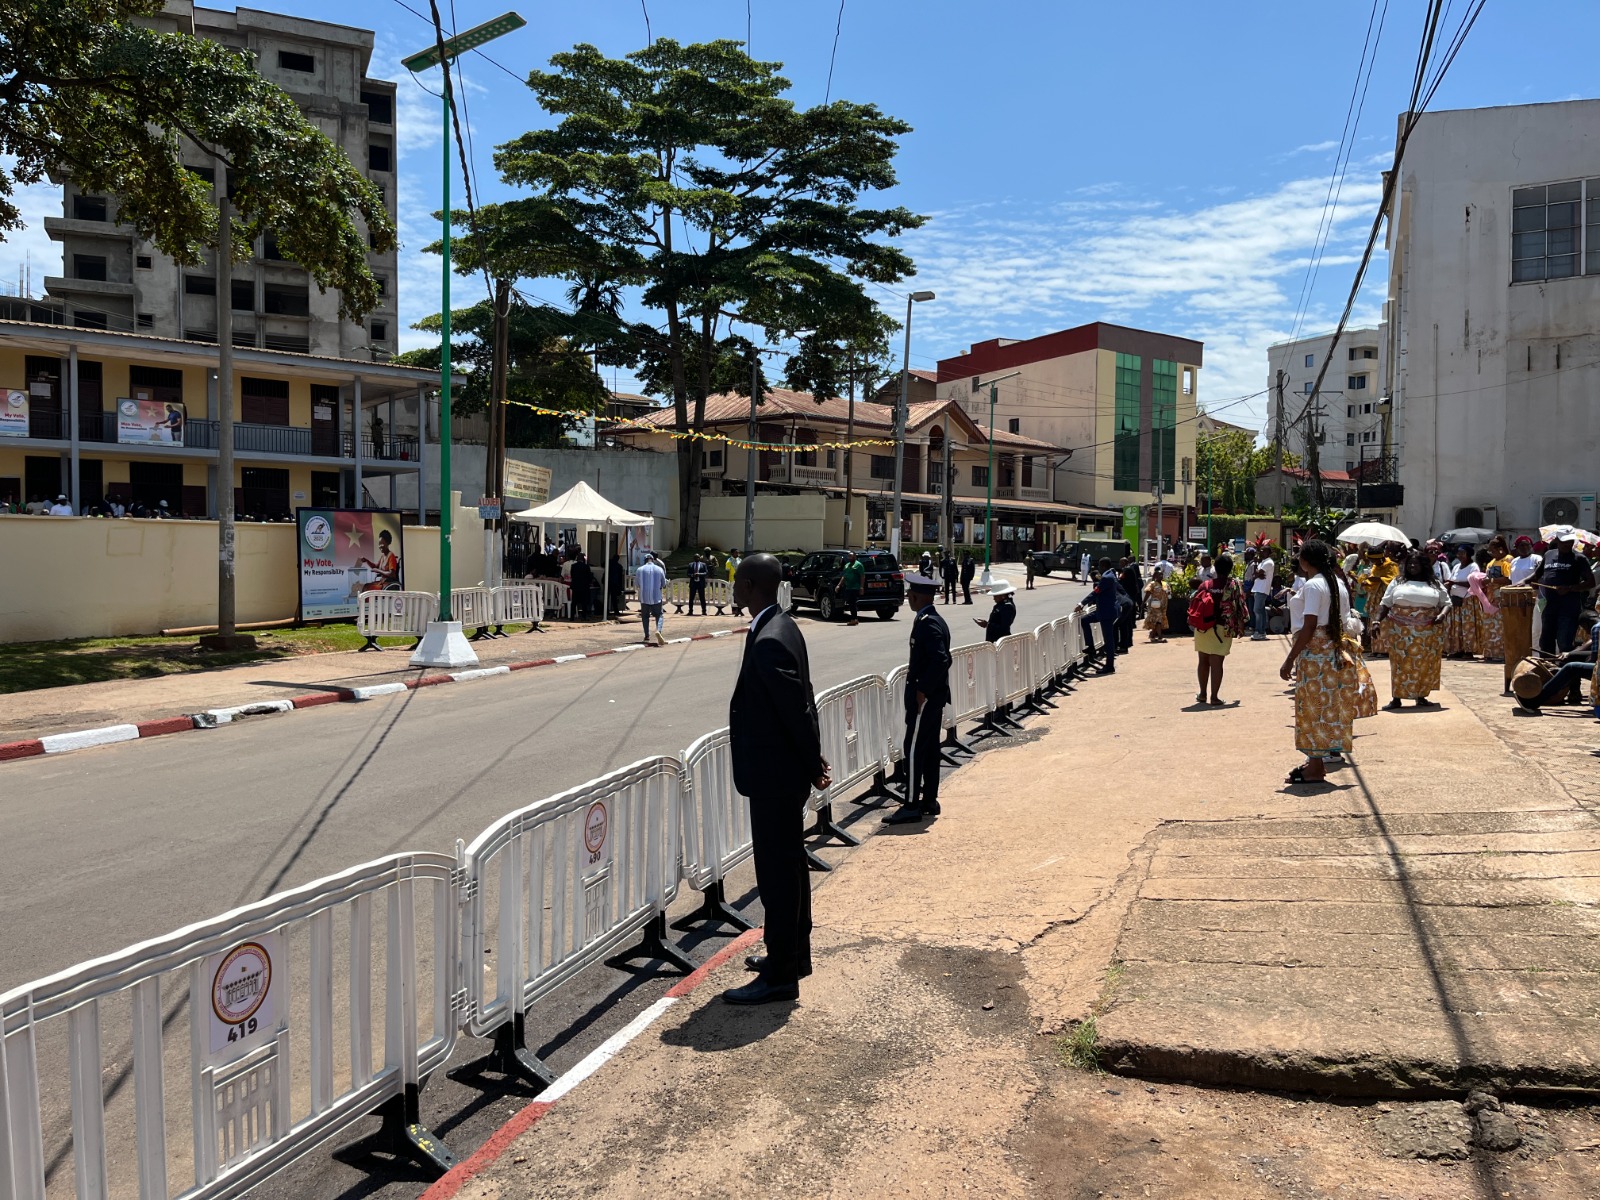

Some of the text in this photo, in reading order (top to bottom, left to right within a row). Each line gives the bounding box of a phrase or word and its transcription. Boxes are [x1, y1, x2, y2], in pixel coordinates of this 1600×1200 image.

[304, 559, 334, 568] My Vote,
[589, 852, 601, 865] 490
[227, 1017, 258, 1043] 419
